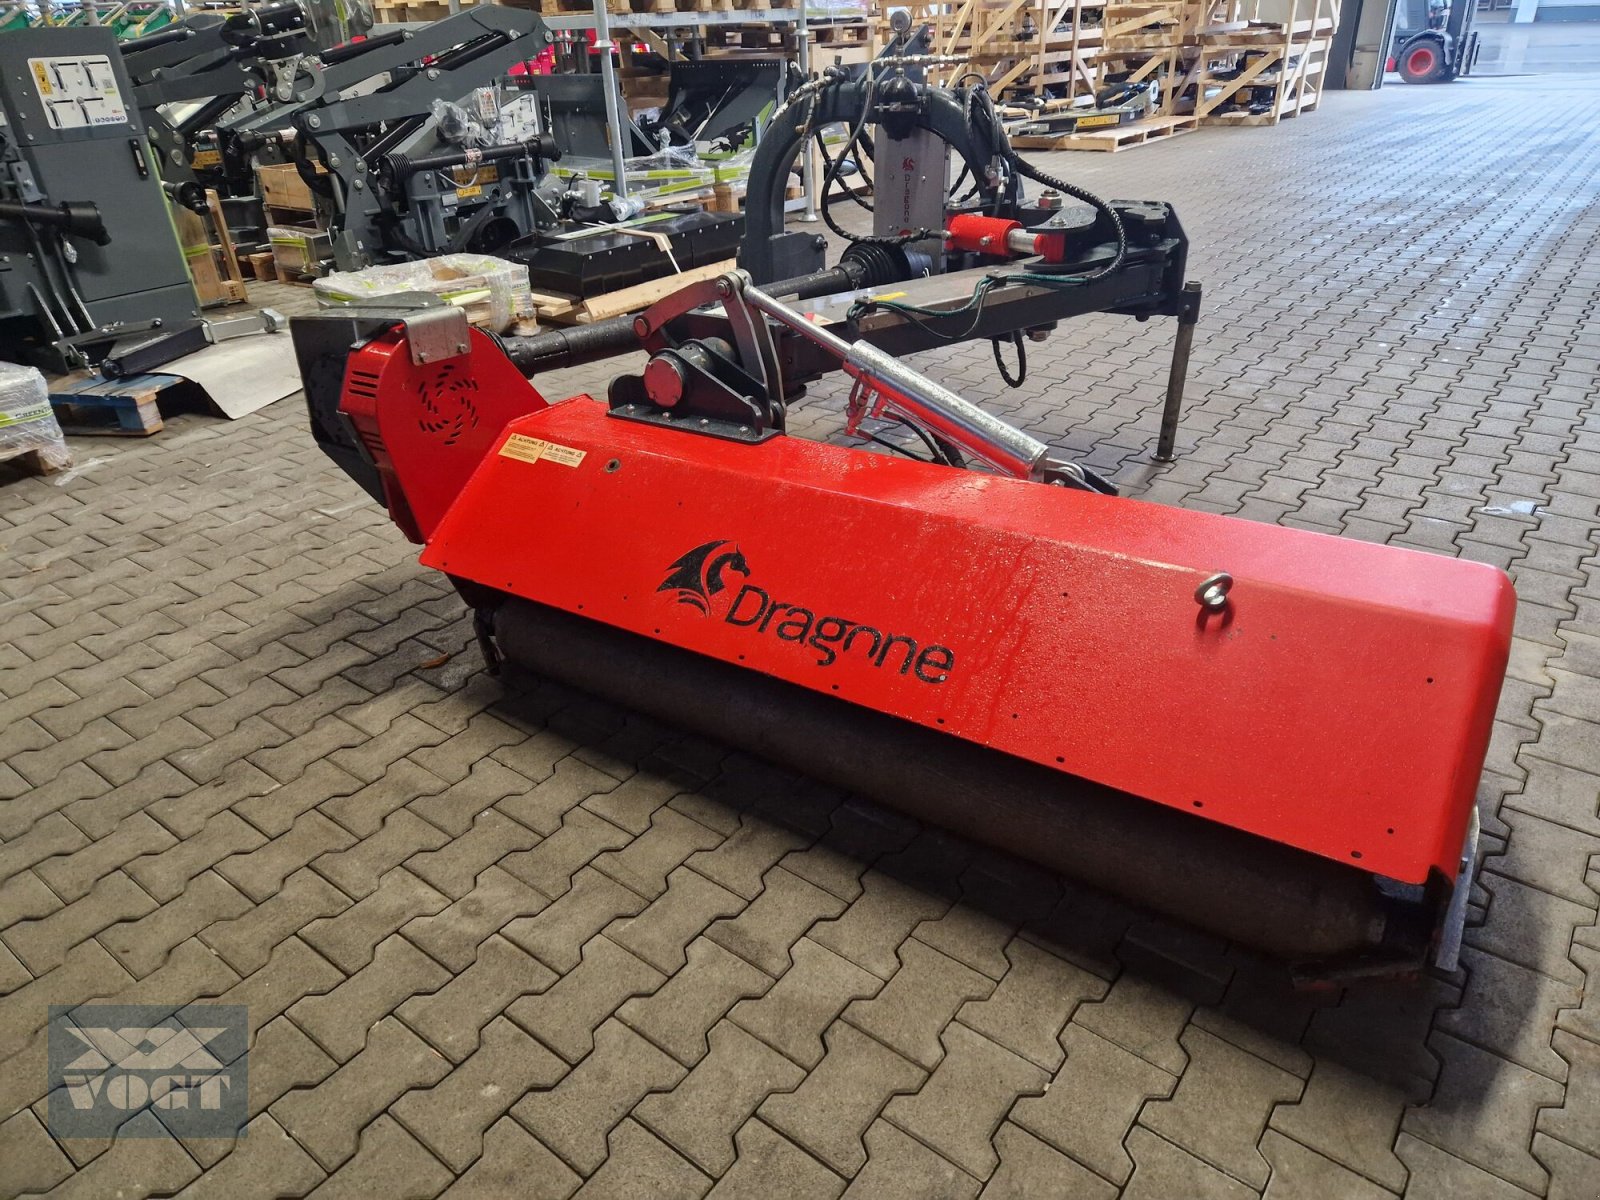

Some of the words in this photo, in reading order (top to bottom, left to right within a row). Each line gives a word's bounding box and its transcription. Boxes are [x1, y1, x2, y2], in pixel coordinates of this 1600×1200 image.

[517, 437, 538, 446] ACHTUNG
[554, 447, 576, 456] ACHTUNG
[725, 584, 955, 684] Dragone
